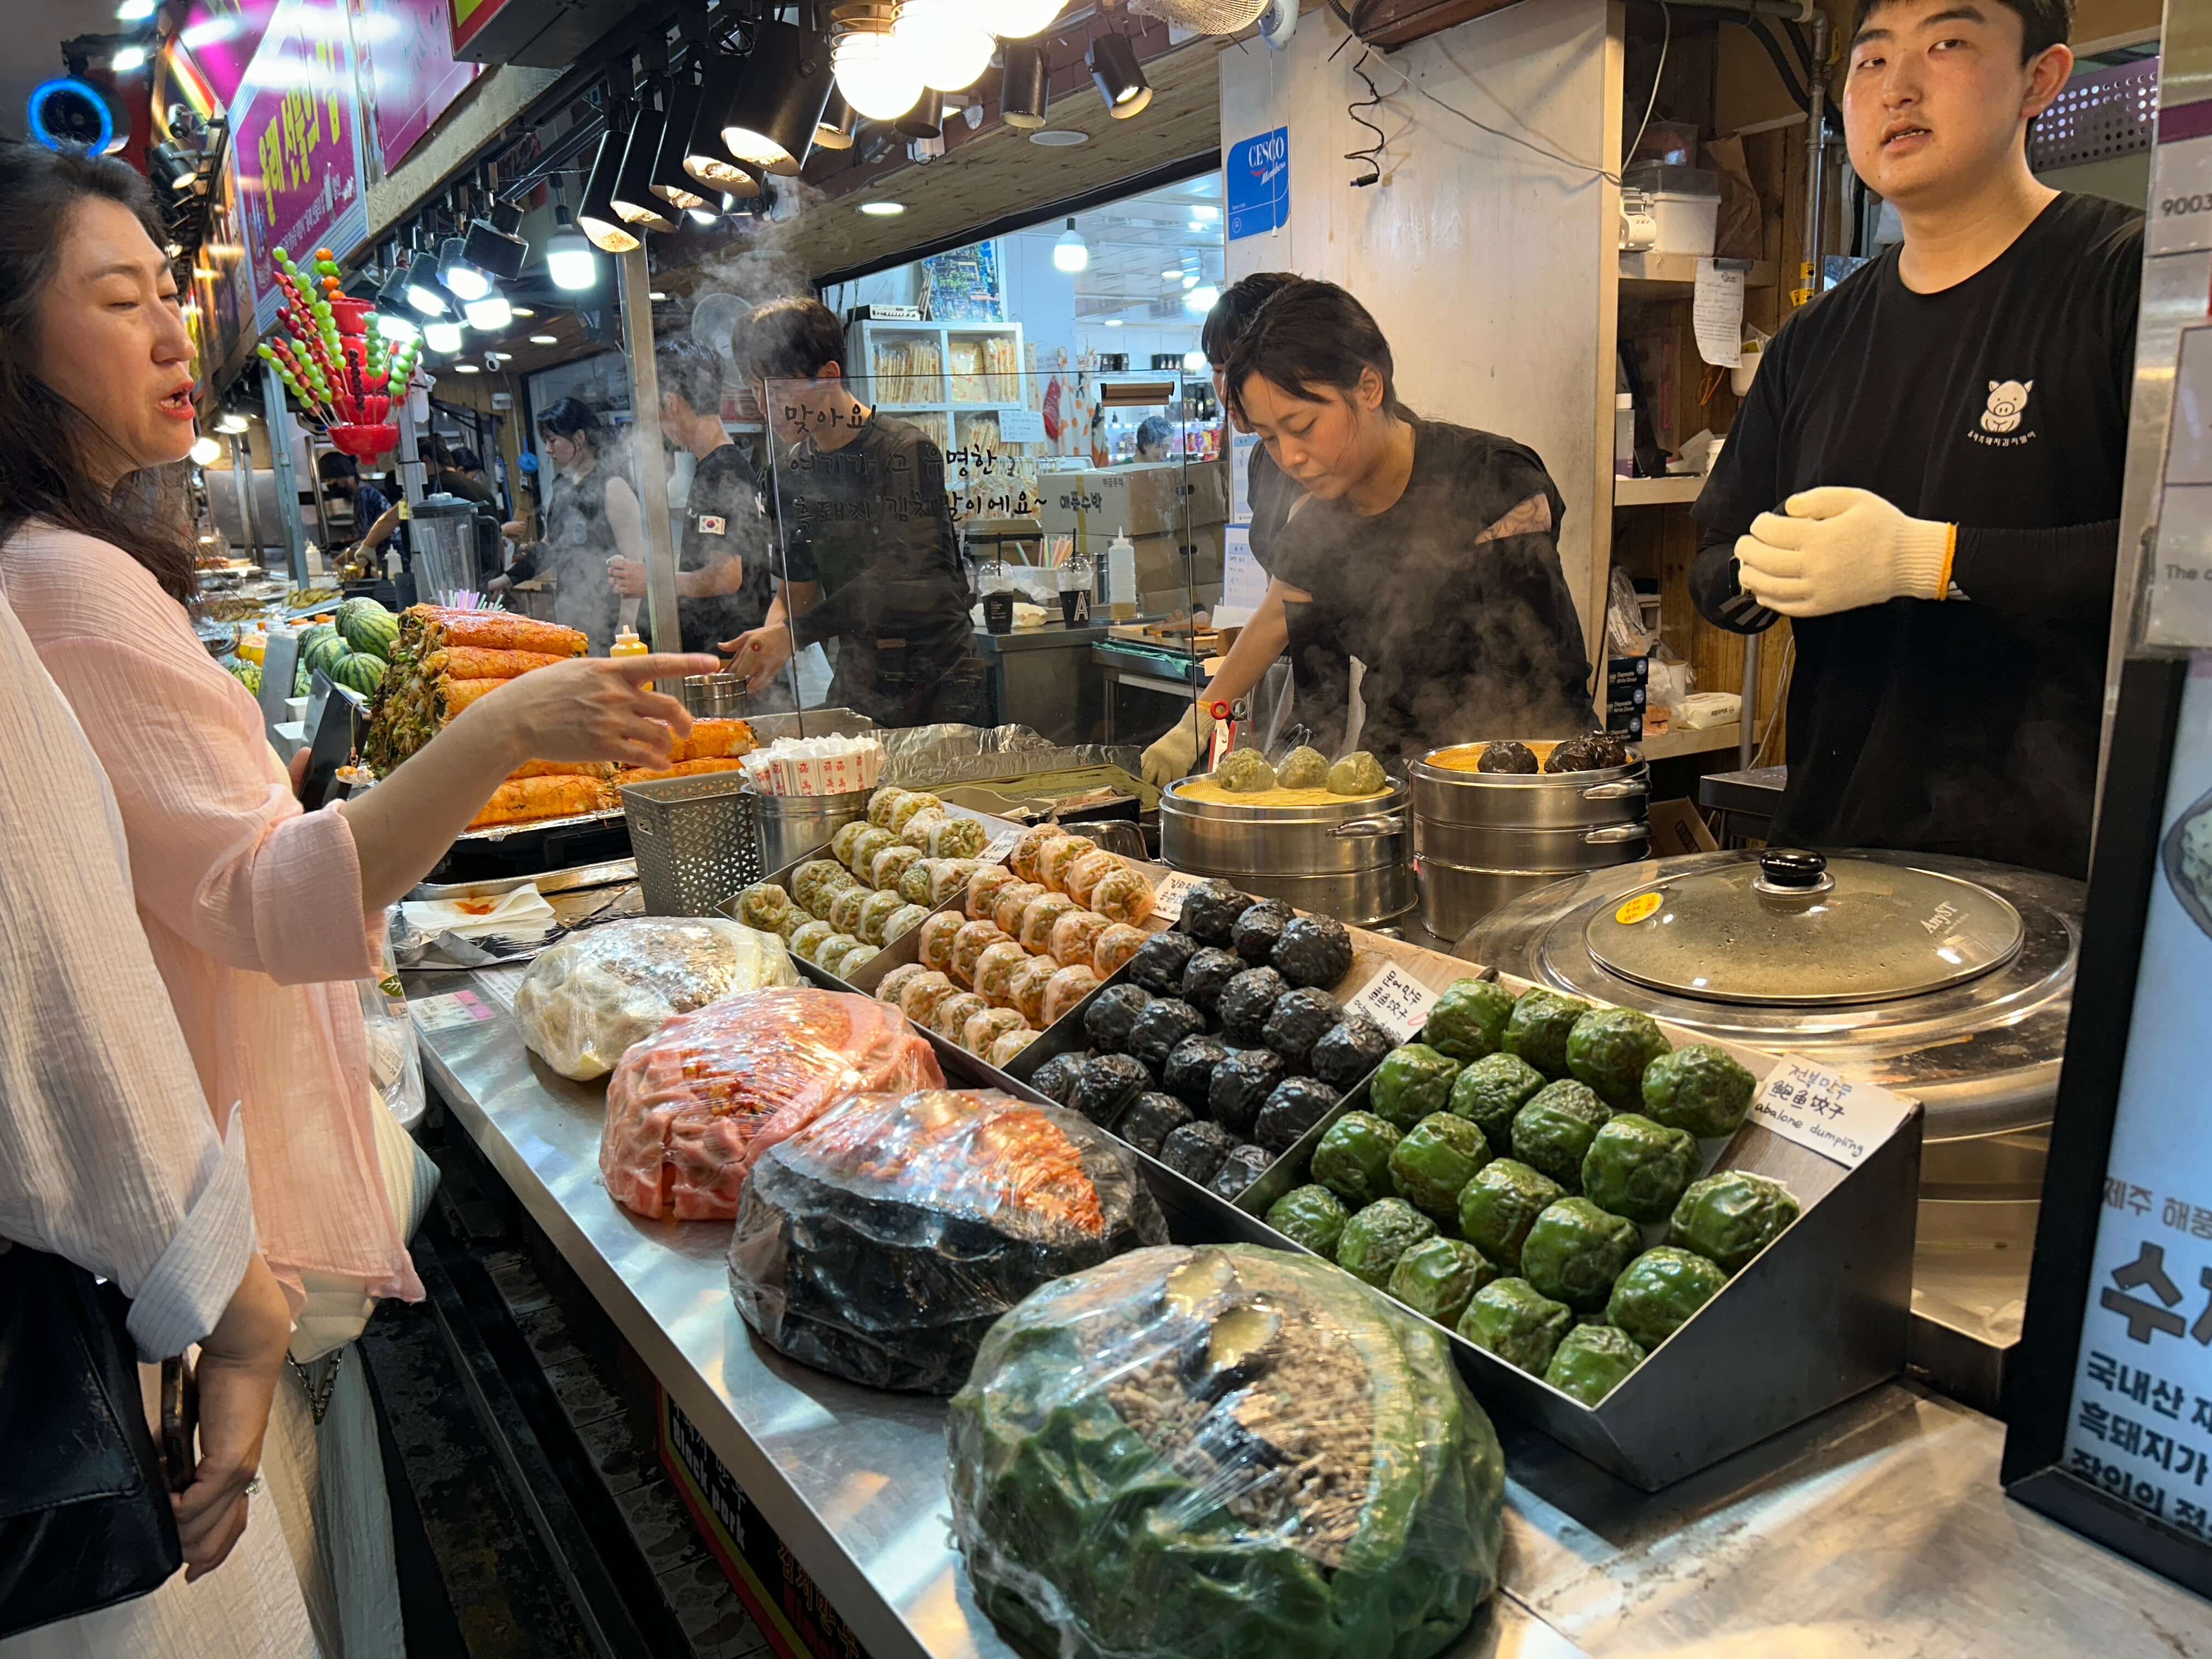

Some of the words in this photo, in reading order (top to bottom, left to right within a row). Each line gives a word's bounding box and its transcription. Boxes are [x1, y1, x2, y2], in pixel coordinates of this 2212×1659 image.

[1249, 137, 1284, 167] CESCO
[258, 116, 285, 227] 올레
[785, 404, 877, 434] 맞아요!
[789, 452, 878, 475] 여기가
[923, 444, 997, 479] 유명한
[1103, 477, 1124, 488] 취급주의
[794, 495, 871, 531] 흑돼지
[1060, 491, 1102, 514] 애플수박
[2166, 564, 2198, 580] The
[1768, 1080, 1846, 1120] 鲍鱼饺子
[1788, 1063, 1853, 1100] 전복만두
[1755, 1102, 1803, 1129] abalone
[1810, 1122, 1865, 1158] dumpling
[2103, 1177, 2154, 1216] 제주
[2087, 1350, 2185, 1420] 국내산
[673, 1415, 708, 1495] Black
[2078, 1400, 2208, 1486] 흑돼지가
